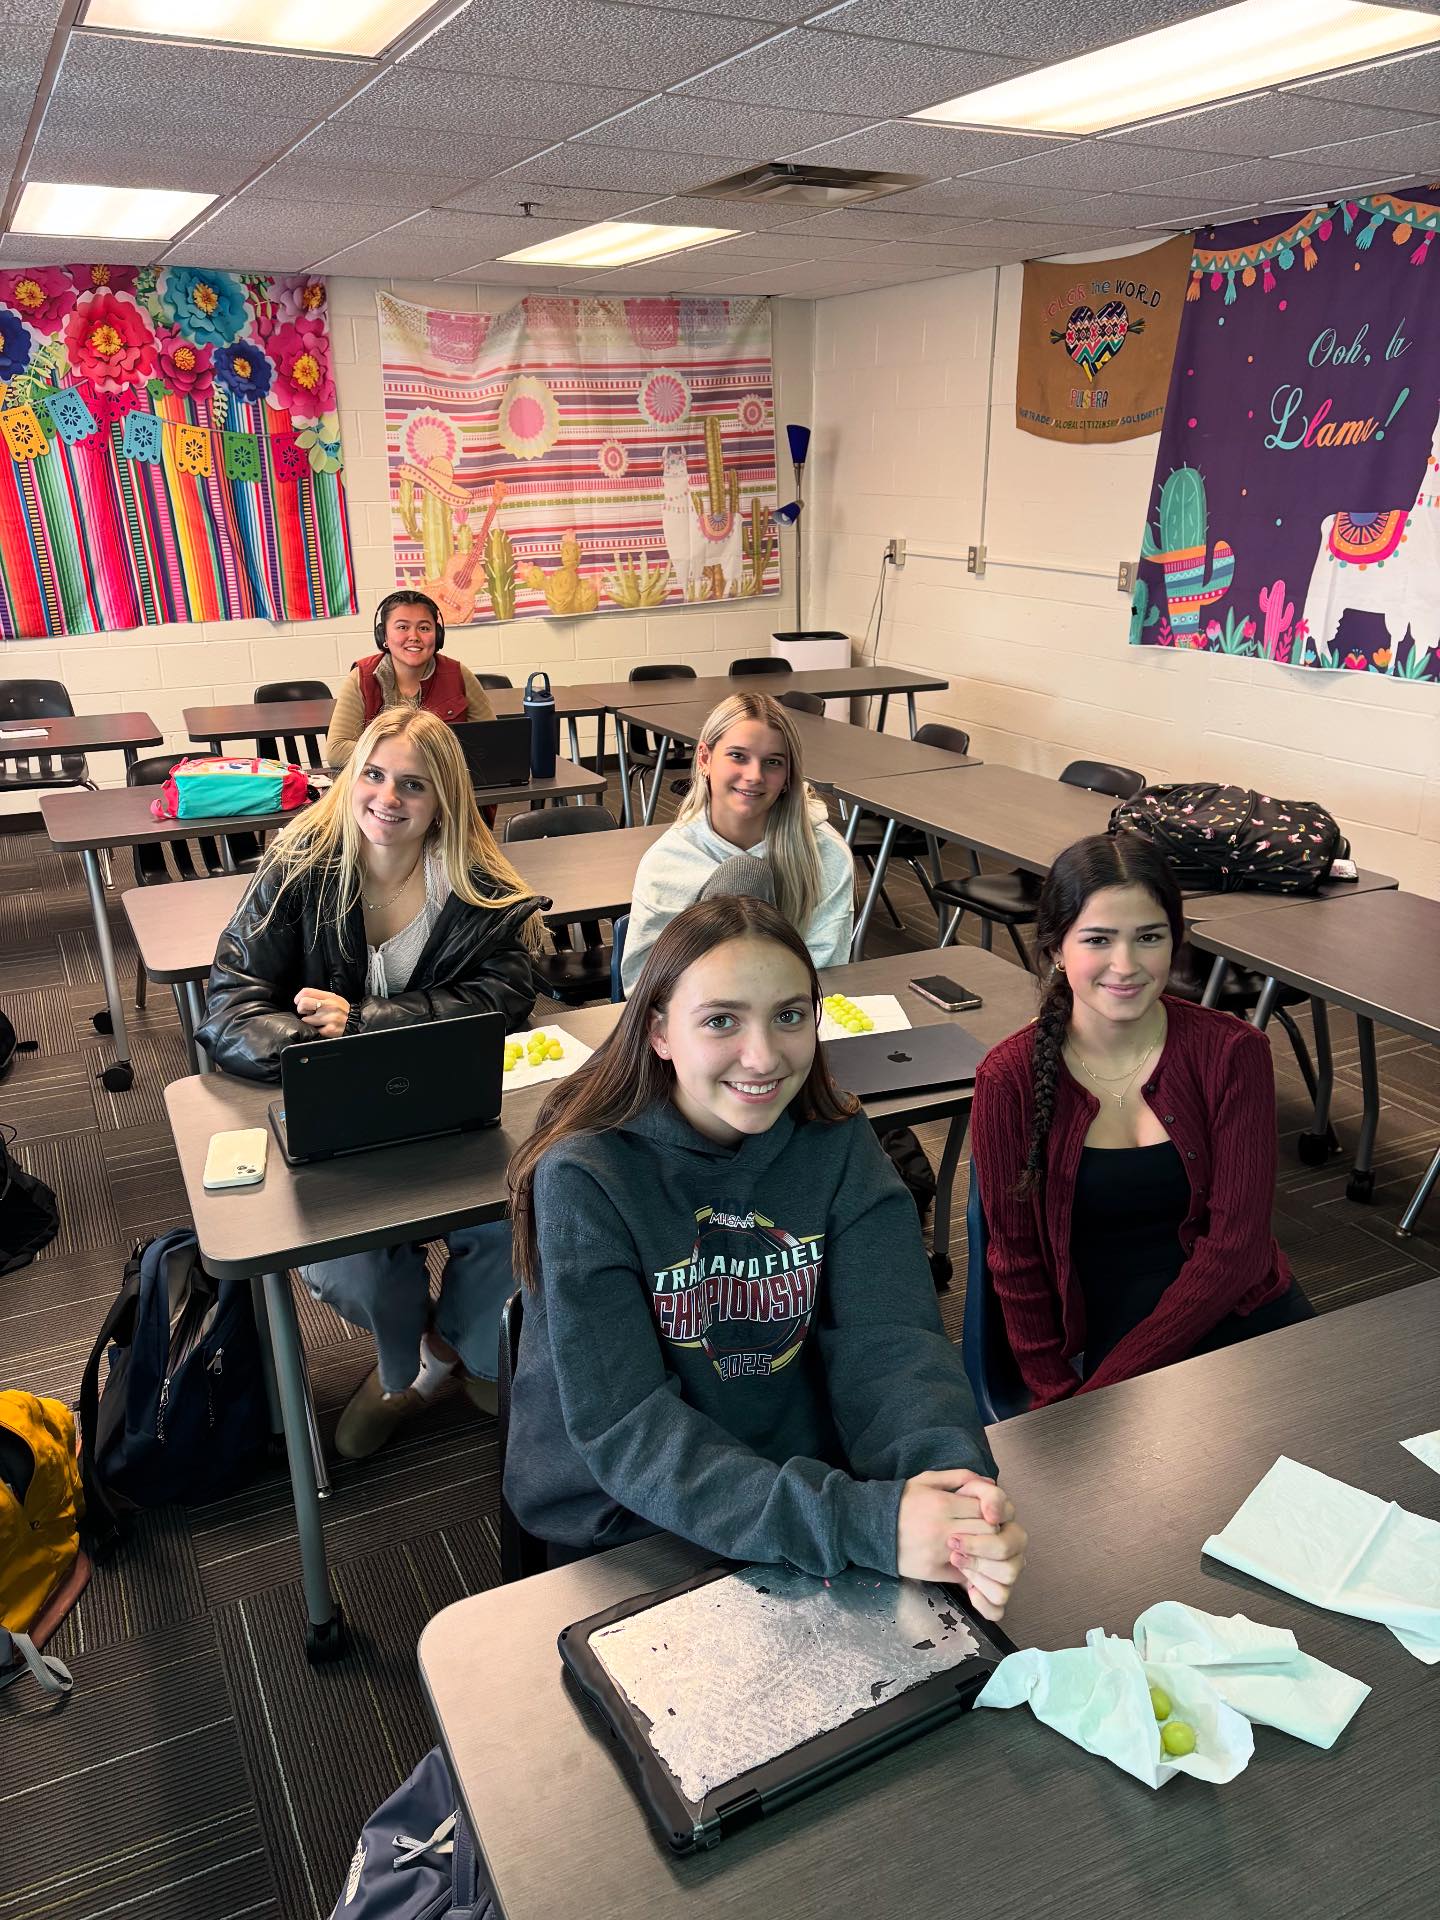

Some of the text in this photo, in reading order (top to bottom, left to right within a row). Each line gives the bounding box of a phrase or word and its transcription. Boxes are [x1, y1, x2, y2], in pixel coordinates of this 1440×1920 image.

[1308, 323, 1371, 368] Ooh,
[765, 1241, 824, 1275] FIEL
[719, 1353, 772, 1382] 2025
